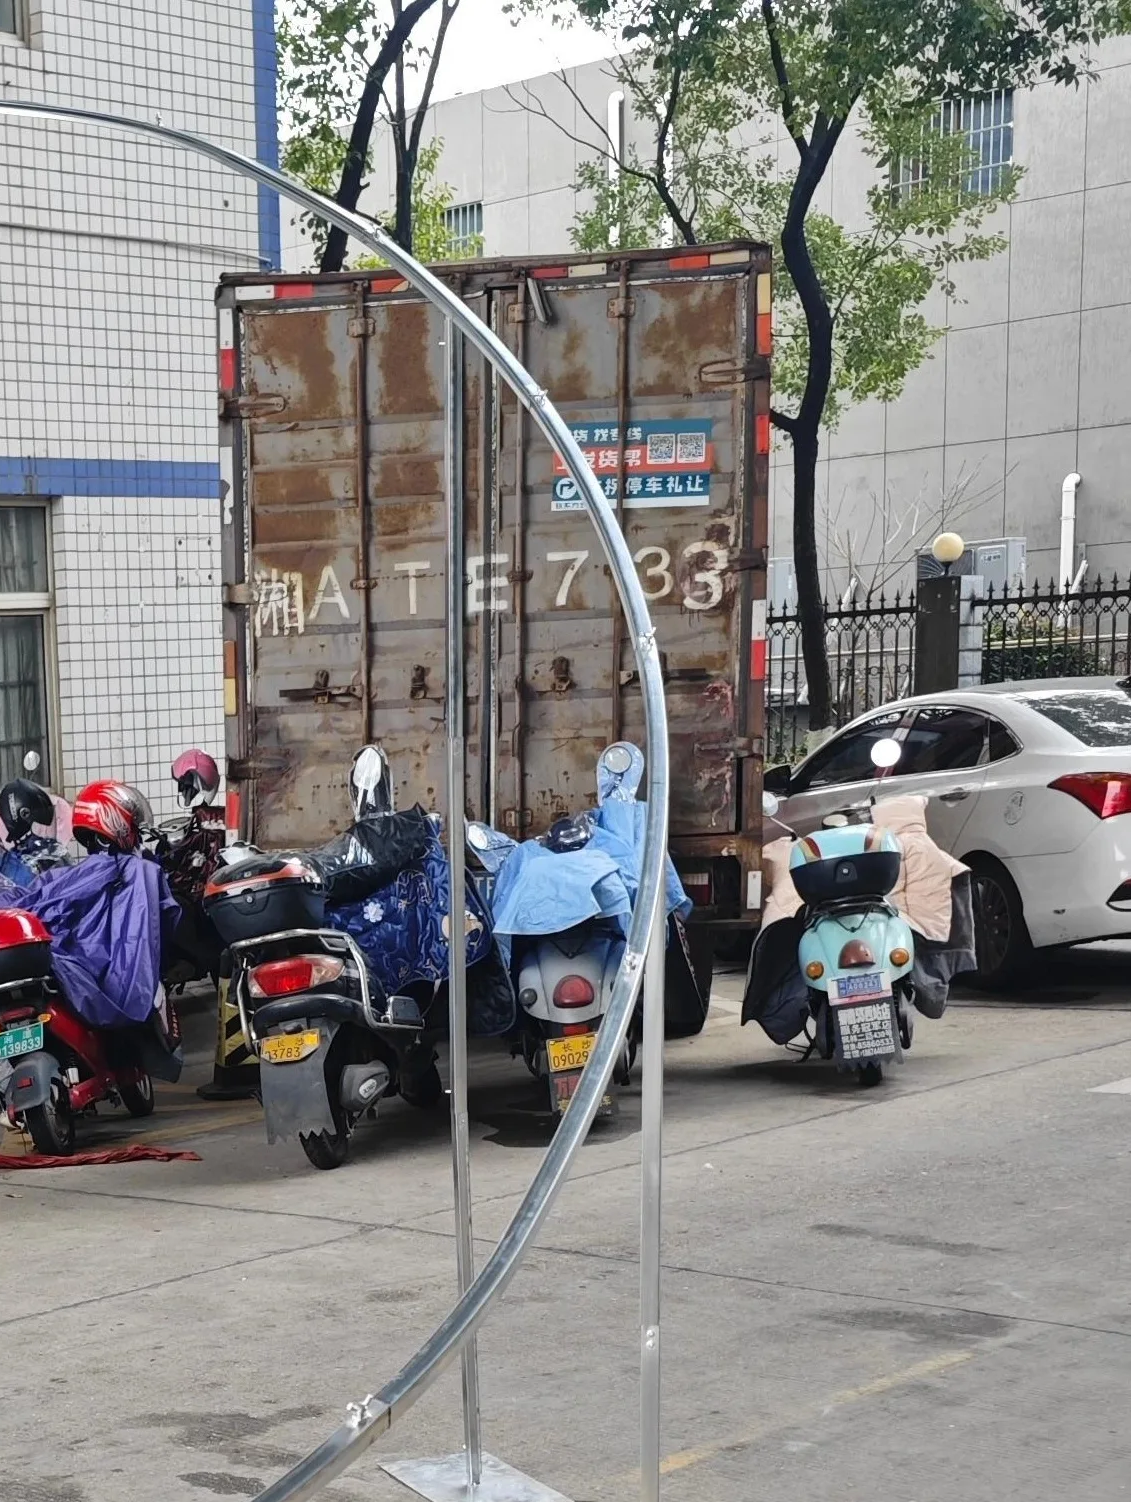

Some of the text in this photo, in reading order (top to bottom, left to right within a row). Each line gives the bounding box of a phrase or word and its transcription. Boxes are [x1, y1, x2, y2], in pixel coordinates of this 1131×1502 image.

[598, 474, 704, 496] 拐停车礼让
[562, 1039, 591, 1052] 长沙
[553, 1049, 592, 1068] 09029
